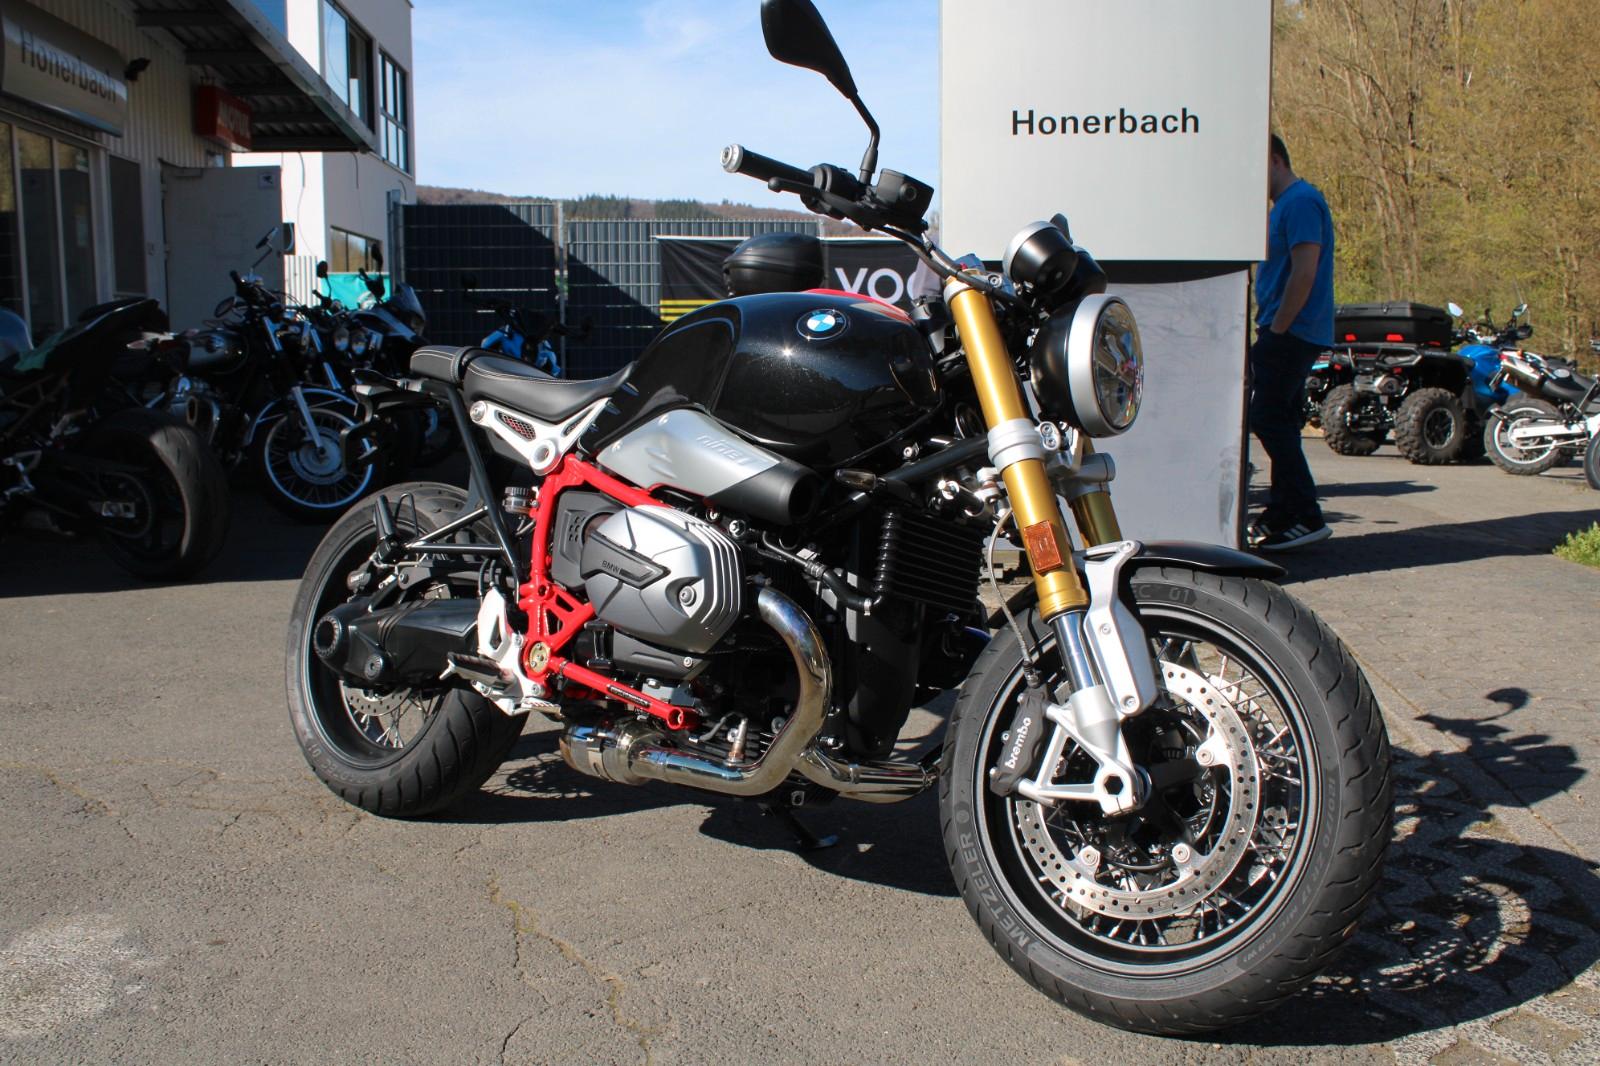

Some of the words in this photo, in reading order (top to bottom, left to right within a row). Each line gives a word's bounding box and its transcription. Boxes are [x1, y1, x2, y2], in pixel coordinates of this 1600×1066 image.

[20, 27, 117, 103] Honerbach
[1012, 107, 1200, 136] Honerbach
[601, 559, 620, 575] BMW
[1004, 716, 1032, 769] brembo
[958, 832, 1032, 949] METZELER
